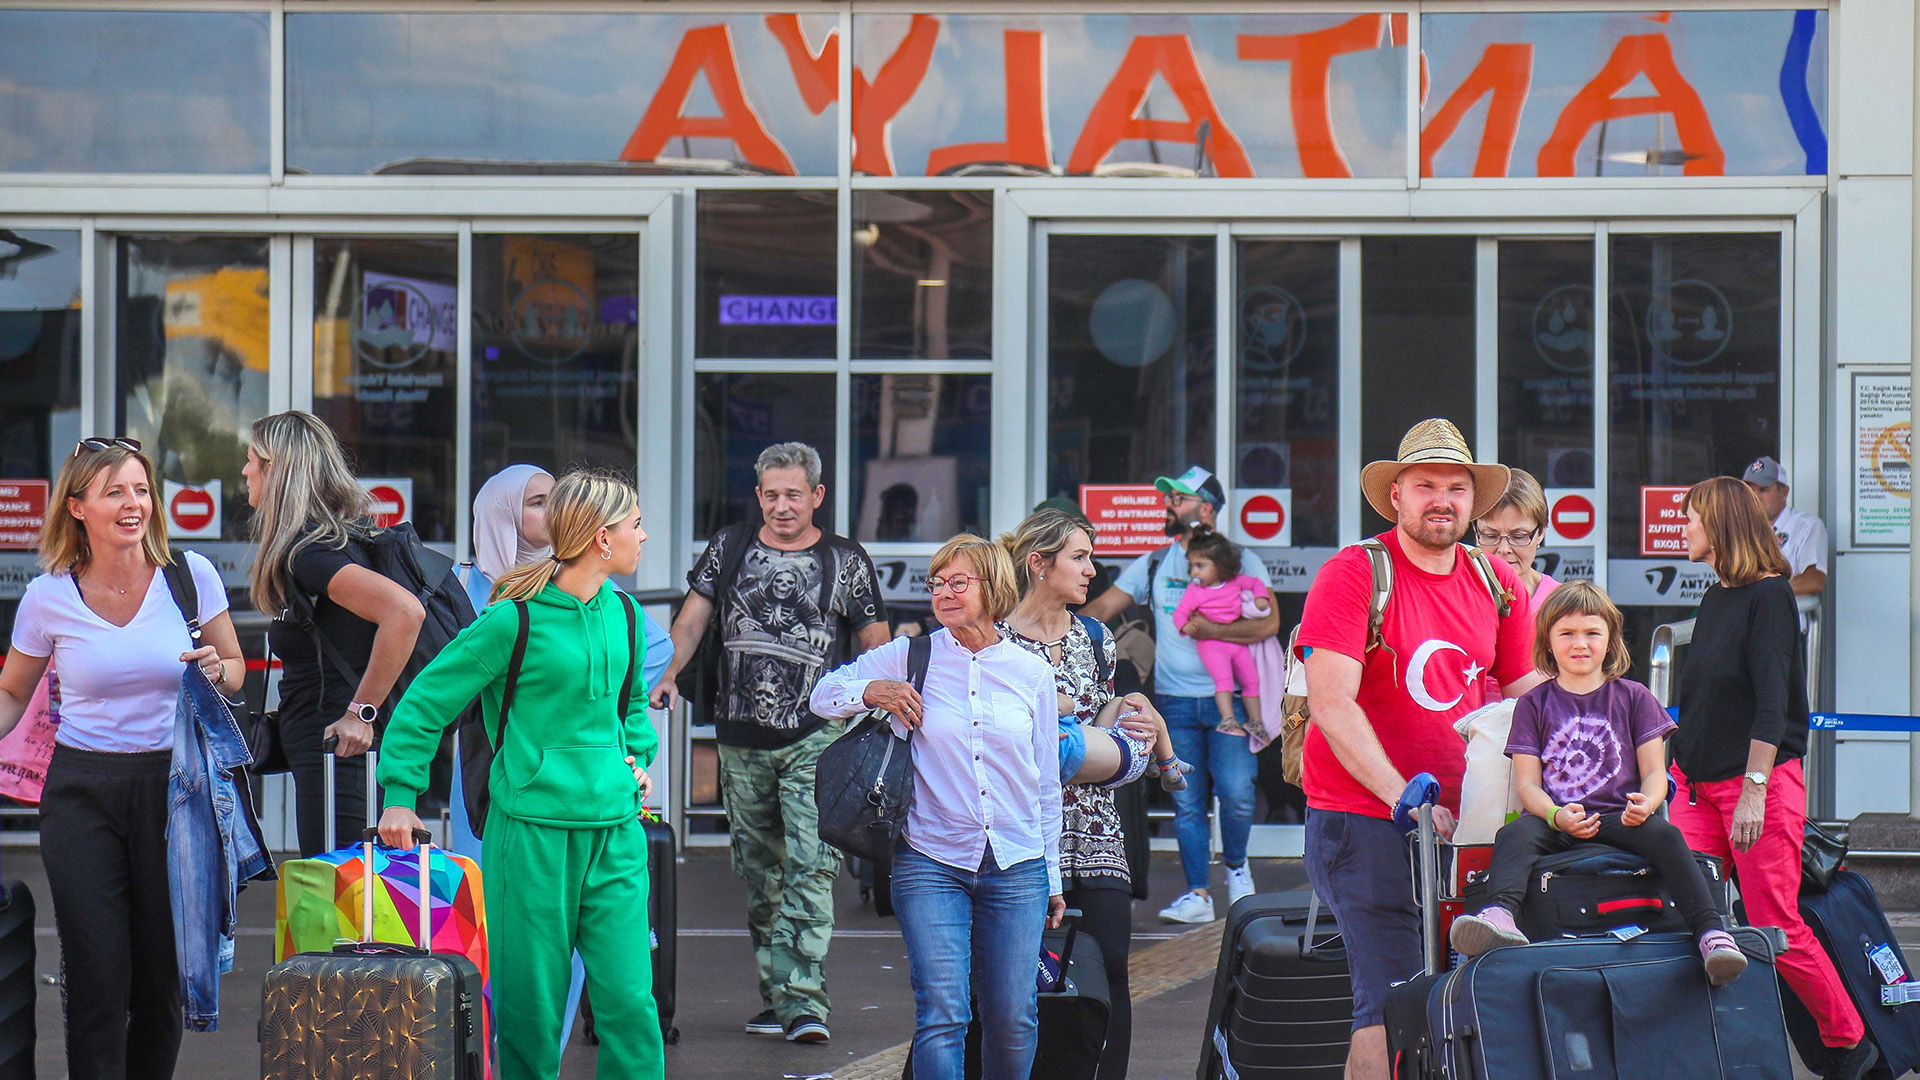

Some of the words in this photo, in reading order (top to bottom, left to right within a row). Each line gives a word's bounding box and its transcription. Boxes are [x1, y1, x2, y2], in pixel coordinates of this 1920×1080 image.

[1101, 509, 1116, 518] NO
[1660, 509, 1675, 518] NO
[1653, 539, 1680, 550] ВХОД
